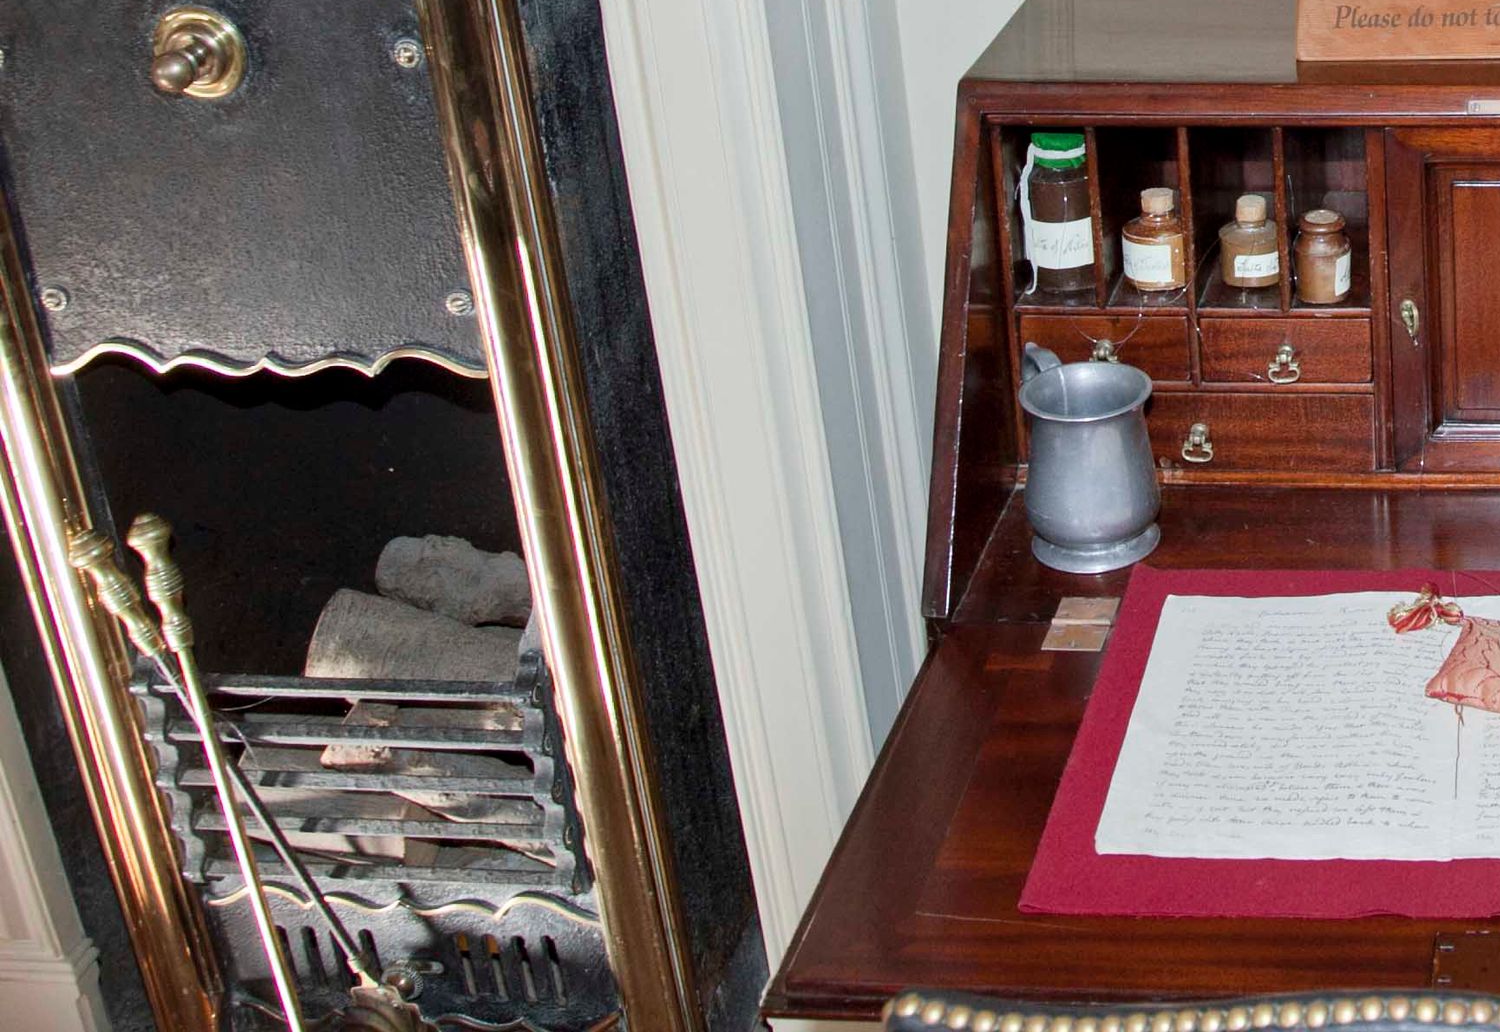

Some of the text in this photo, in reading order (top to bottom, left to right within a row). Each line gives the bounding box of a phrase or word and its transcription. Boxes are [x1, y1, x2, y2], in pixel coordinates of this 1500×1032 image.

[1333, 4, 1402, 29] Please
[1408, 5, 1434, 28] do
[1441, 9, 1479, 27] not
